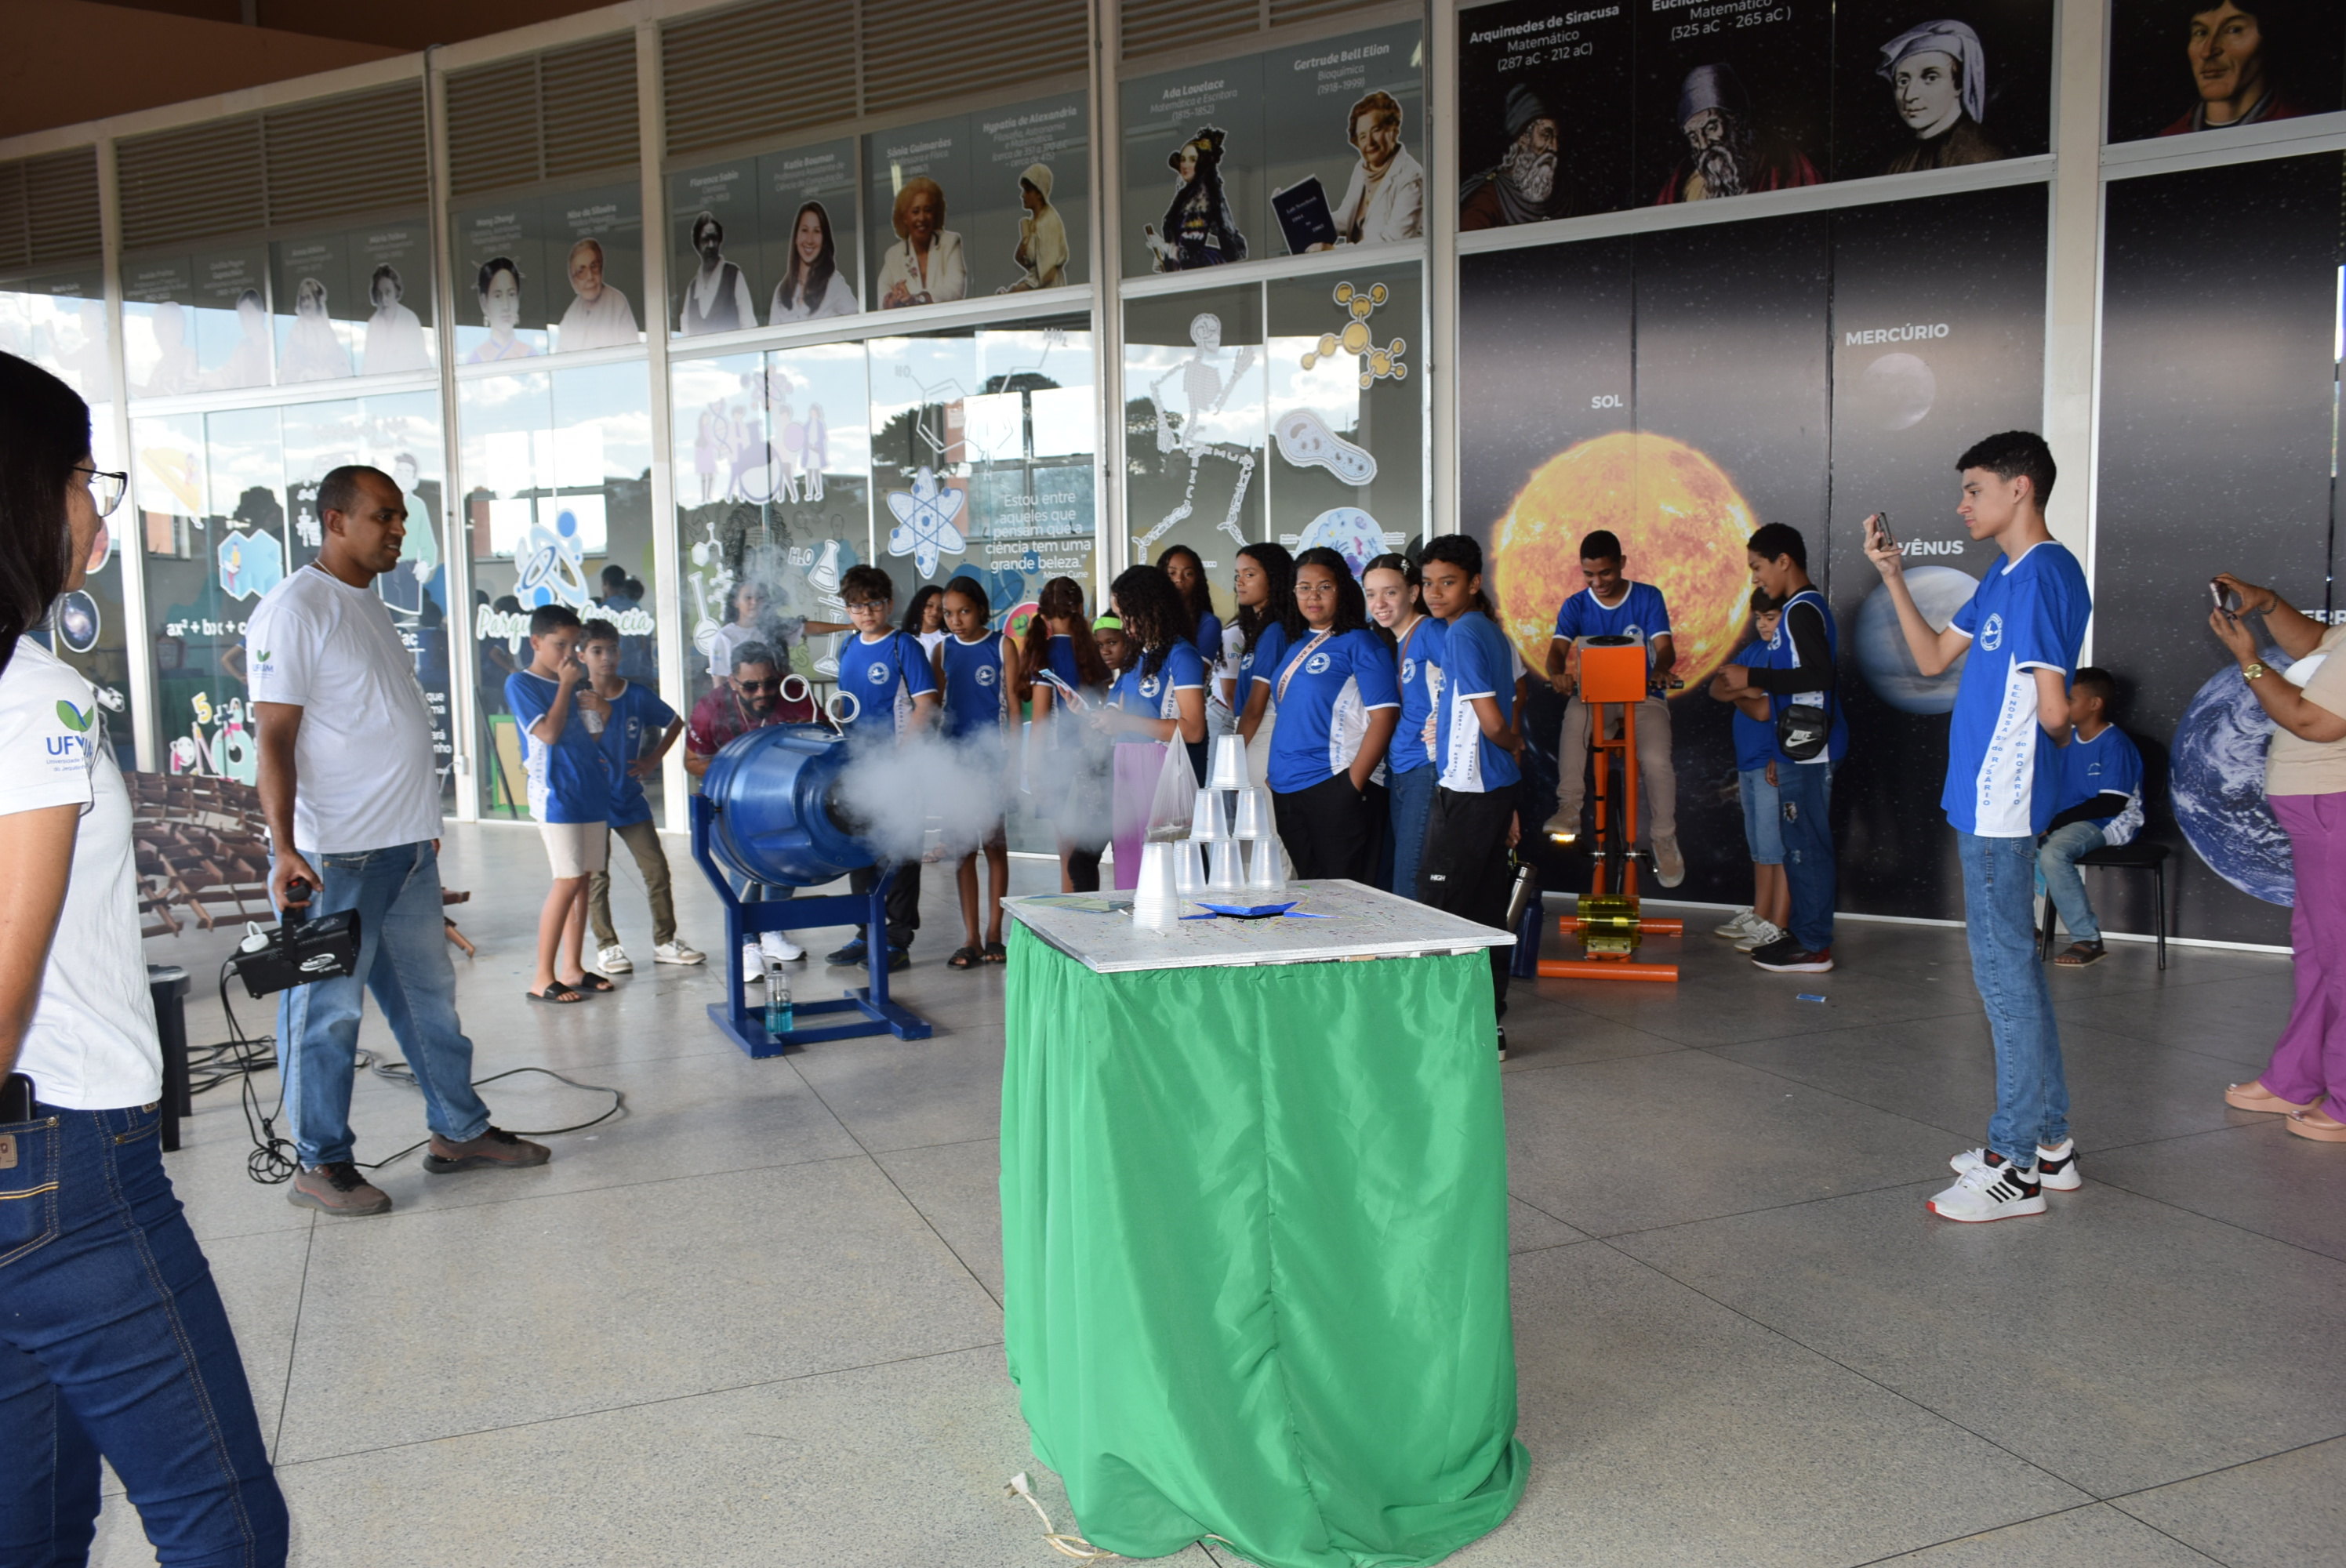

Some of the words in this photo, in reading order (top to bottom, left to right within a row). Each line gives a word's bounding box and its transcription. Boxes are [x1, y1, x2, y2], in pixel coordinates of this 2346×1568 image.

[1469, 20, 1545, 44] Arquimedes
[1547, 16, 1563, 29] de
[1565, 5, 1620, 25] Siracusa
[1671, 23, 1700, 41] (325
[1702, 20, 1720, 34] aC
[1735, 12, 1762, 27] 265
[1765, 8, 1784, 23] aC
[1507, 30, 1580, 53] Matemático
[1294, 53, 1339, 71] Gertrude
[1341, 48, 1361, 62] Bell
[1363, 44, 1390, 58] Elion
[1498, 55, 1523, 72] (287
[1525, 53, 1541, 66] aC
[1551, 47, 1570, 61] 212
[1573, 42, 1593, 57] aC)
[1318, 64, 1365, 81] Bioquímica
[1162, 88, 1181, 100] Ada
[1182, 79, 1225, 96] Lovelace
[1203, 89, 1238, 103] Escritora
[982, 117, 1017, 134] Hypatia
[1018, 115, 1029, 125] de
[1029, 106, 1077, 124] Alexandria
[1846, 322, 1950, 347] MERCÚRIO
[1591, 394, 1623, 409] SOL
[1042, 492, 1077, 505] entre
[1000, 509, 1048, 526] aqueles
[1051, 510, 1077, 523] que
[993, 525, 1044, 541] pensam
[1046, 524, 1071, 538] que
[1075, 524, 1083, 534] a
[985, 540, 1029, 554] ciência
[1032, 540, 1058, 552] tem
[1061, 539, 1091, 551] uma
[1898, 538, 1965, 557] VÊNUS
[990, 556, 1035, 574] grande
[478, 605, 532, 653] Parqu
[1792, 729, 1813, 740] NIKE
[1983, 757, 1999, 806] RSARIO
[2014, 753, 2024, 805] ROSARIO
